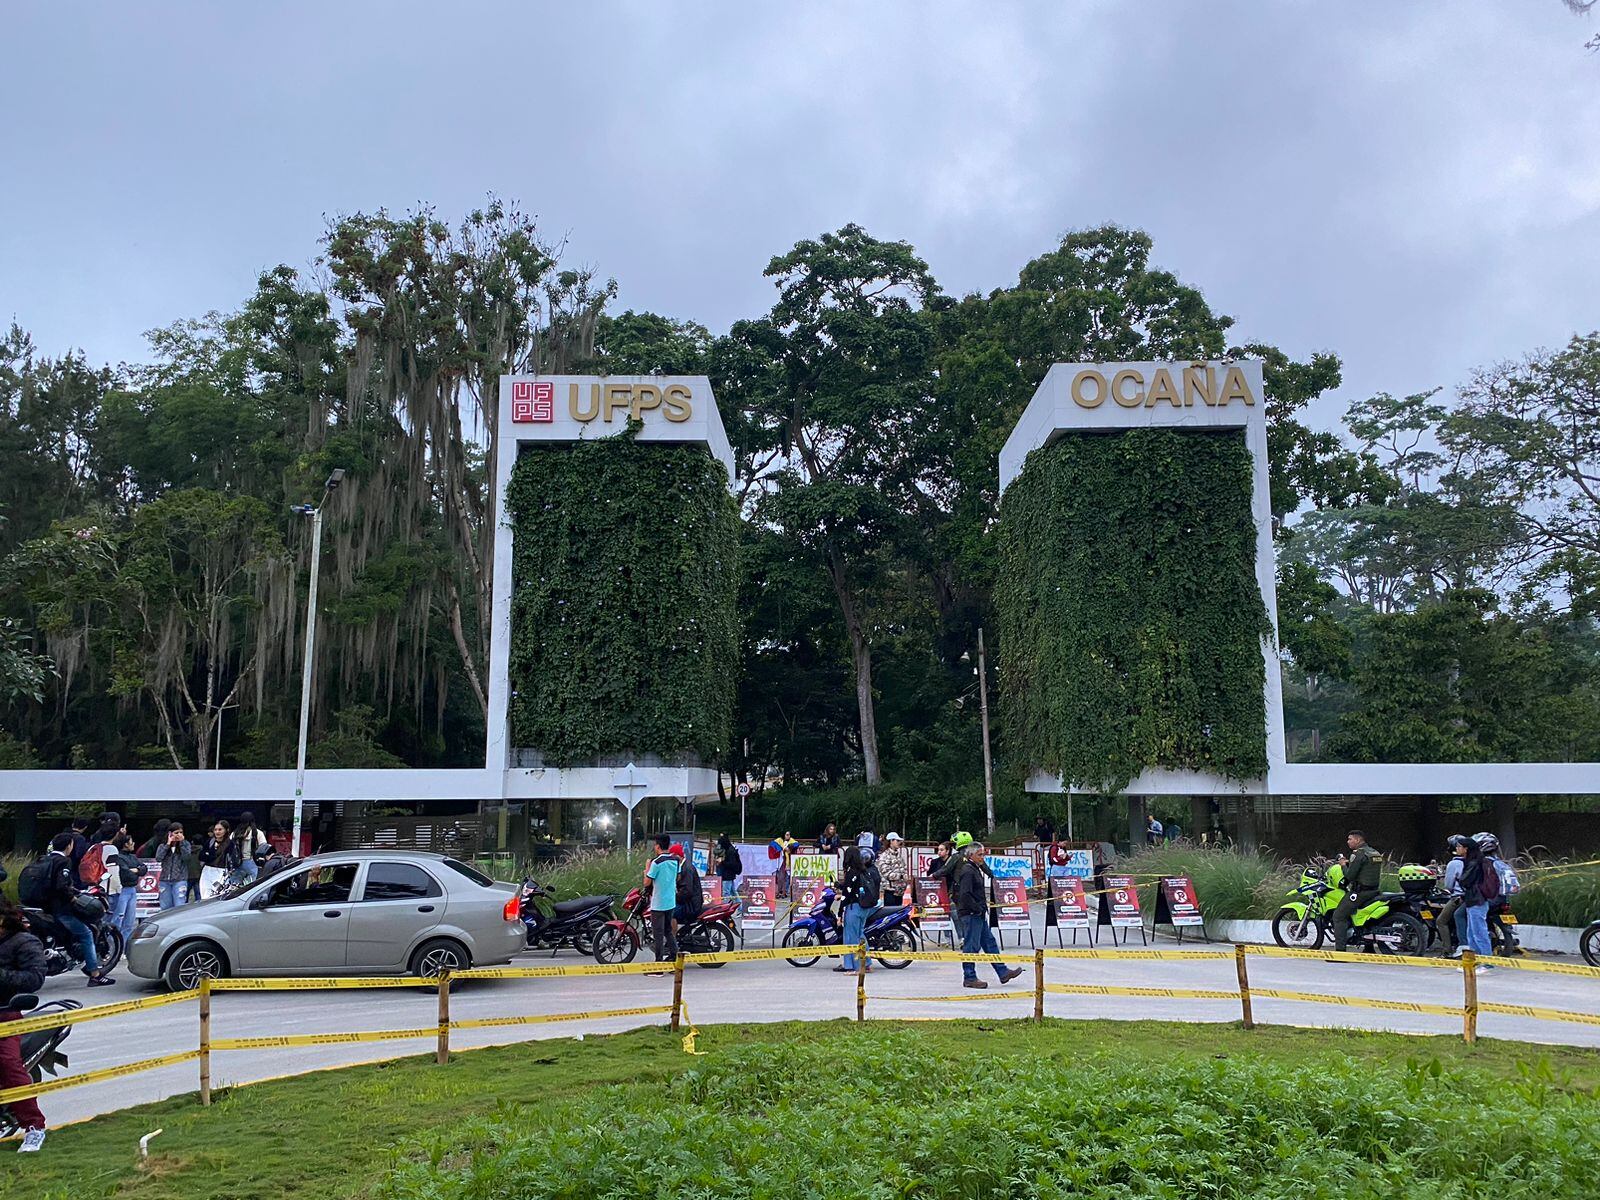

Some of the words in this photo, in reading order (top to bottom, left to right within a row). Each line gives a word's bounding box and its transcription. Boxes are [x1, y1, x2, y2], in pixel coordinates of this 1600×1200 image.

[569, 383, 692, 422] UFPS
[1071, 361, 1255, 408] OCAÑA
[794, 857, 809, 871] NO
[811, 856, 829, 871] HAY
